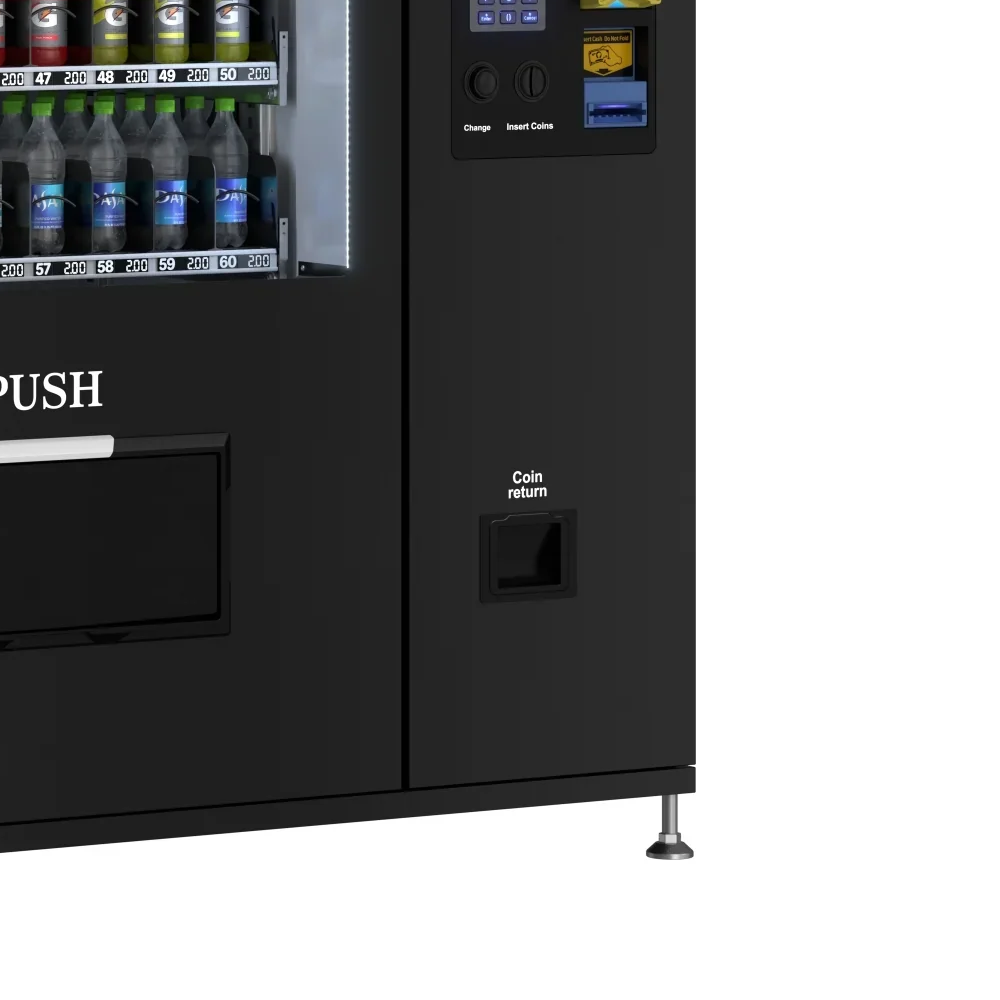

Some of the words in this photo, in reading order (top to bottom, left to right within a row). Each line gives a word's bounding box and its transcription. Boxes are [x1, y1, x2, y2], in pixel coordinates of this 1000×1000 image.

[1, 72, 24, 85] 2.00
[34, 71, 51, 84] 47
[64, 71, 86, 84] 2.00
[96, 70, 114, 83] 48
[125, 69, 147, 83] 2.00
[158, 68, 175, 82] 49
[186, 68, 208, 81] 2.00
[219, 67, 236, 80] 50
[247, 67, 269, 80] 2.00
[464, 124, 491, 133] Change
[506, 122, 529, 131] Insert
[530, 122, 554, 130] Coins
[35, 262, 51, 275] 57
[63, 261, 85, 274] 2.00
[97, 259, 113, 273] 58
[125, 258, 147, 272] 2.00
[159, 257, 175, 270] 59
[187, 256, 208, 269] 2.00
[219, 255, 236, 268] 60
[247, 254, 269, 267] 2.00
[1, 263, 23, 277] 2.00
[512, 470, 543, 484] Coin
[508, 486, 548, 499] return
